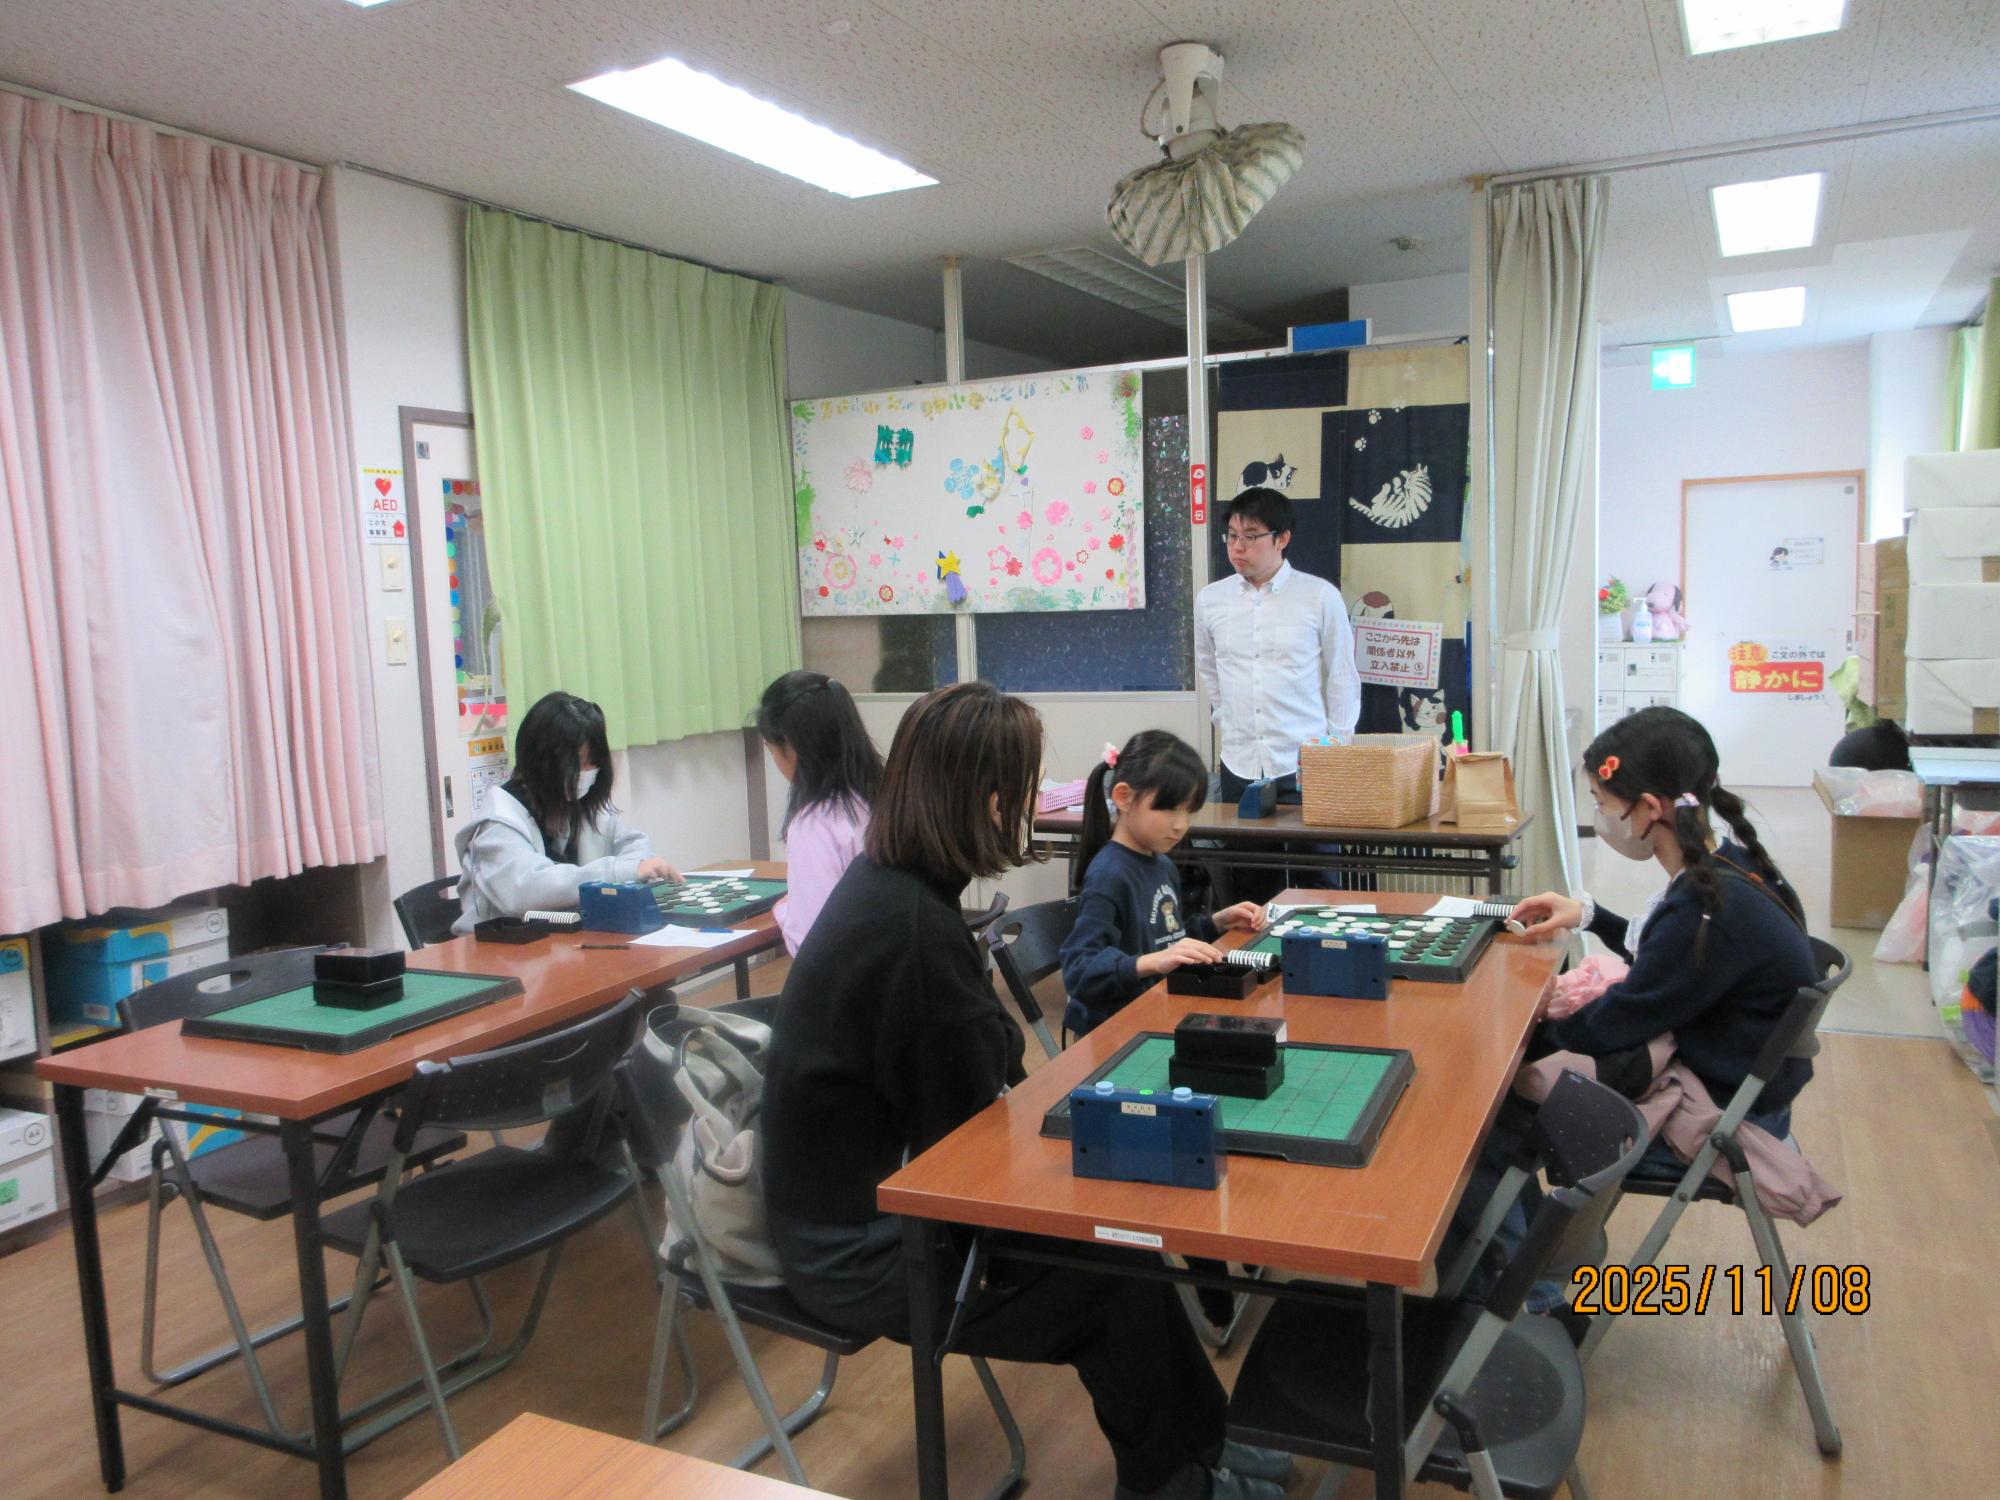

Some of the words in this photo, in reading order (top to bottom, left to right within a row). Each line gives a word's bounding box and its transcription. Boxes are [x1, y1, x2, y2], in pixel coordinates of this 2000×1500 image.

[373, 498, 398, 511] AED
[1365, 632, 1421, 646] ここから先は
[1366, 645, 1416, 660] 関係者以外
[1370, 659, 1410, 673] 立入禁止
[1734, 669, 1819, 690] 静かに
